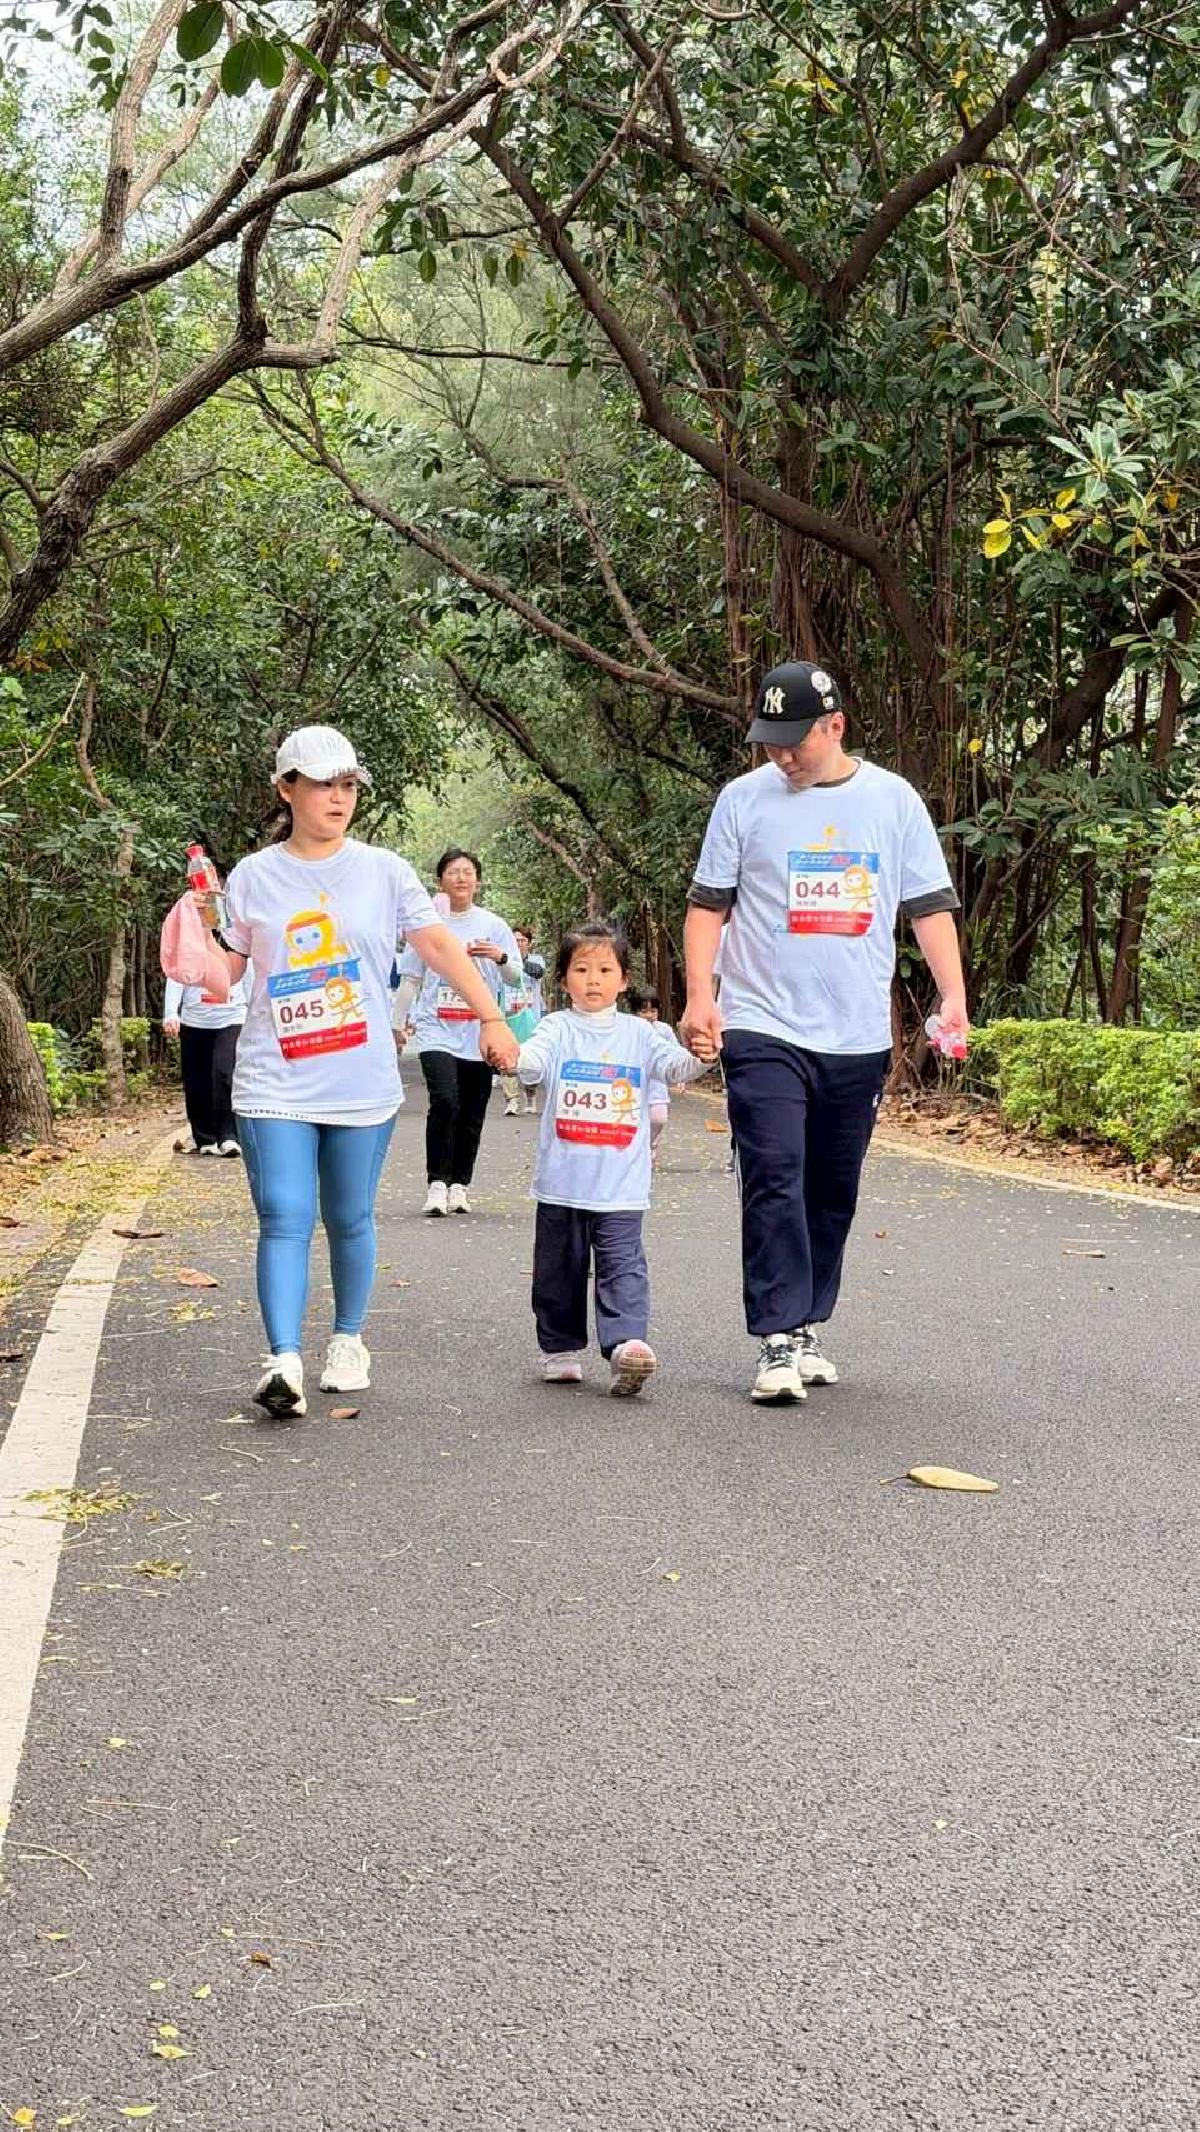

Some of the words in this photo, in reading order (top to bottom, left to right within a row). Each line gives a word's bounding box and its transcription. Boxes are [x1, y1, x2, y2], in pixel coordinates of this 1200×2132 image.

[796, 881, 840, 898] 044
[280, 1000, 324, 1023] 045
[564, 1090, 606, 1110] 043
